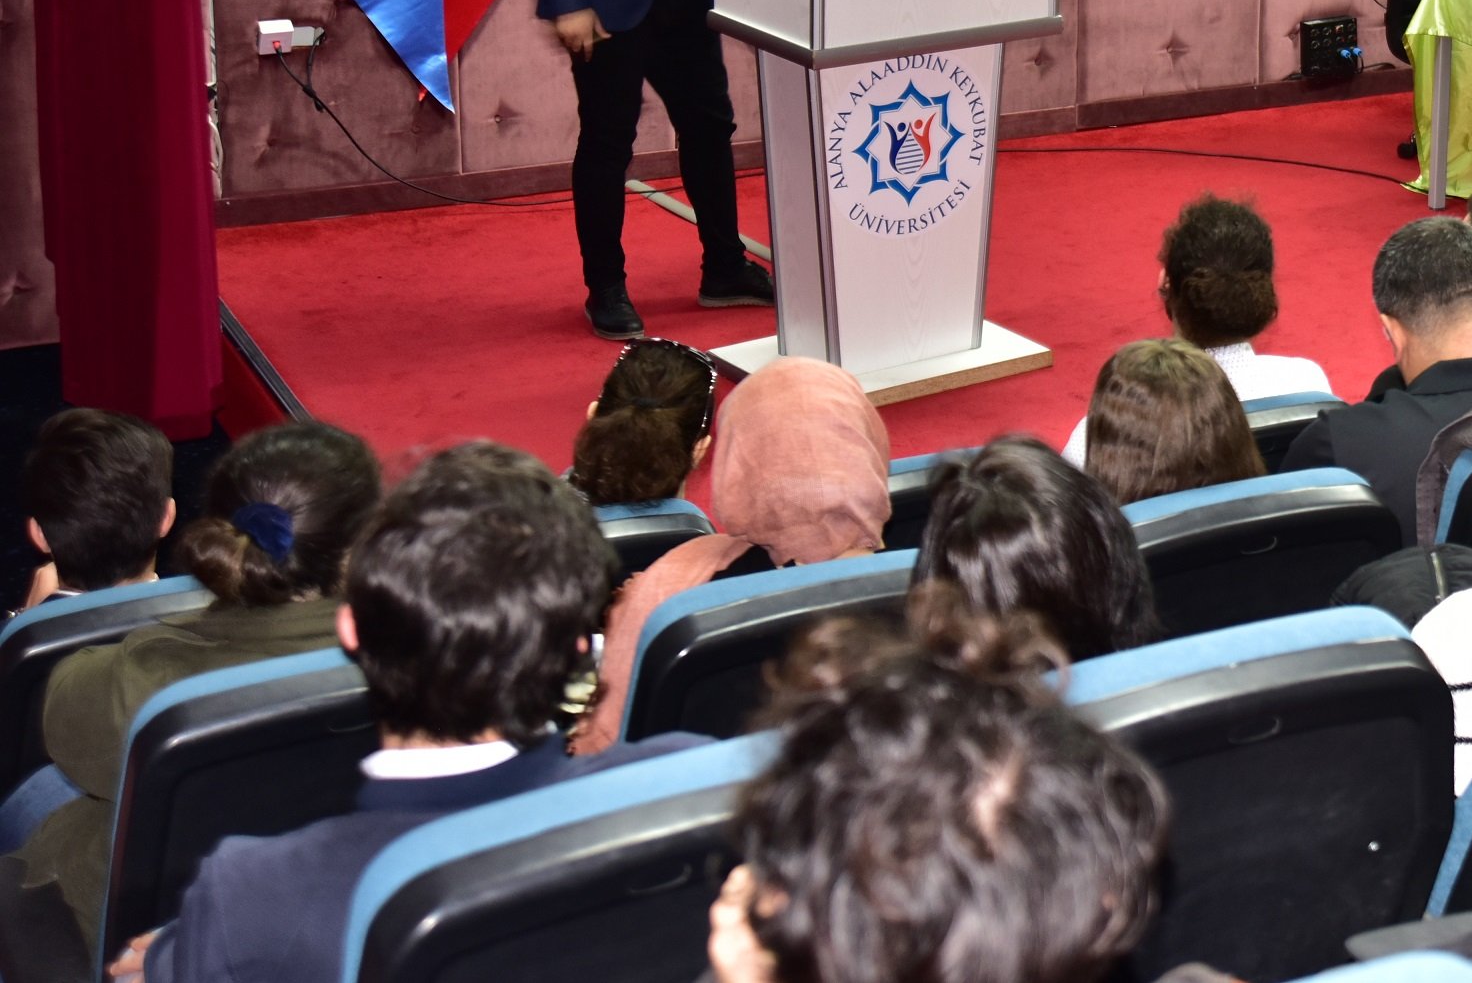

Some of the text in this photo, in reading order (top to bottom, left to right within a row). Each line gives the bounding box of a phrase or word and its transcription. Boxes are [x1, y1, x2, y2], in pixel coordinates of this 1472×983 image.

[828, 111, 852, 190] ALANYA
[950, 66, 986, 165] KEYKUBAT
[849, 179, 972, 235] ÜNİVERSİTESİ
